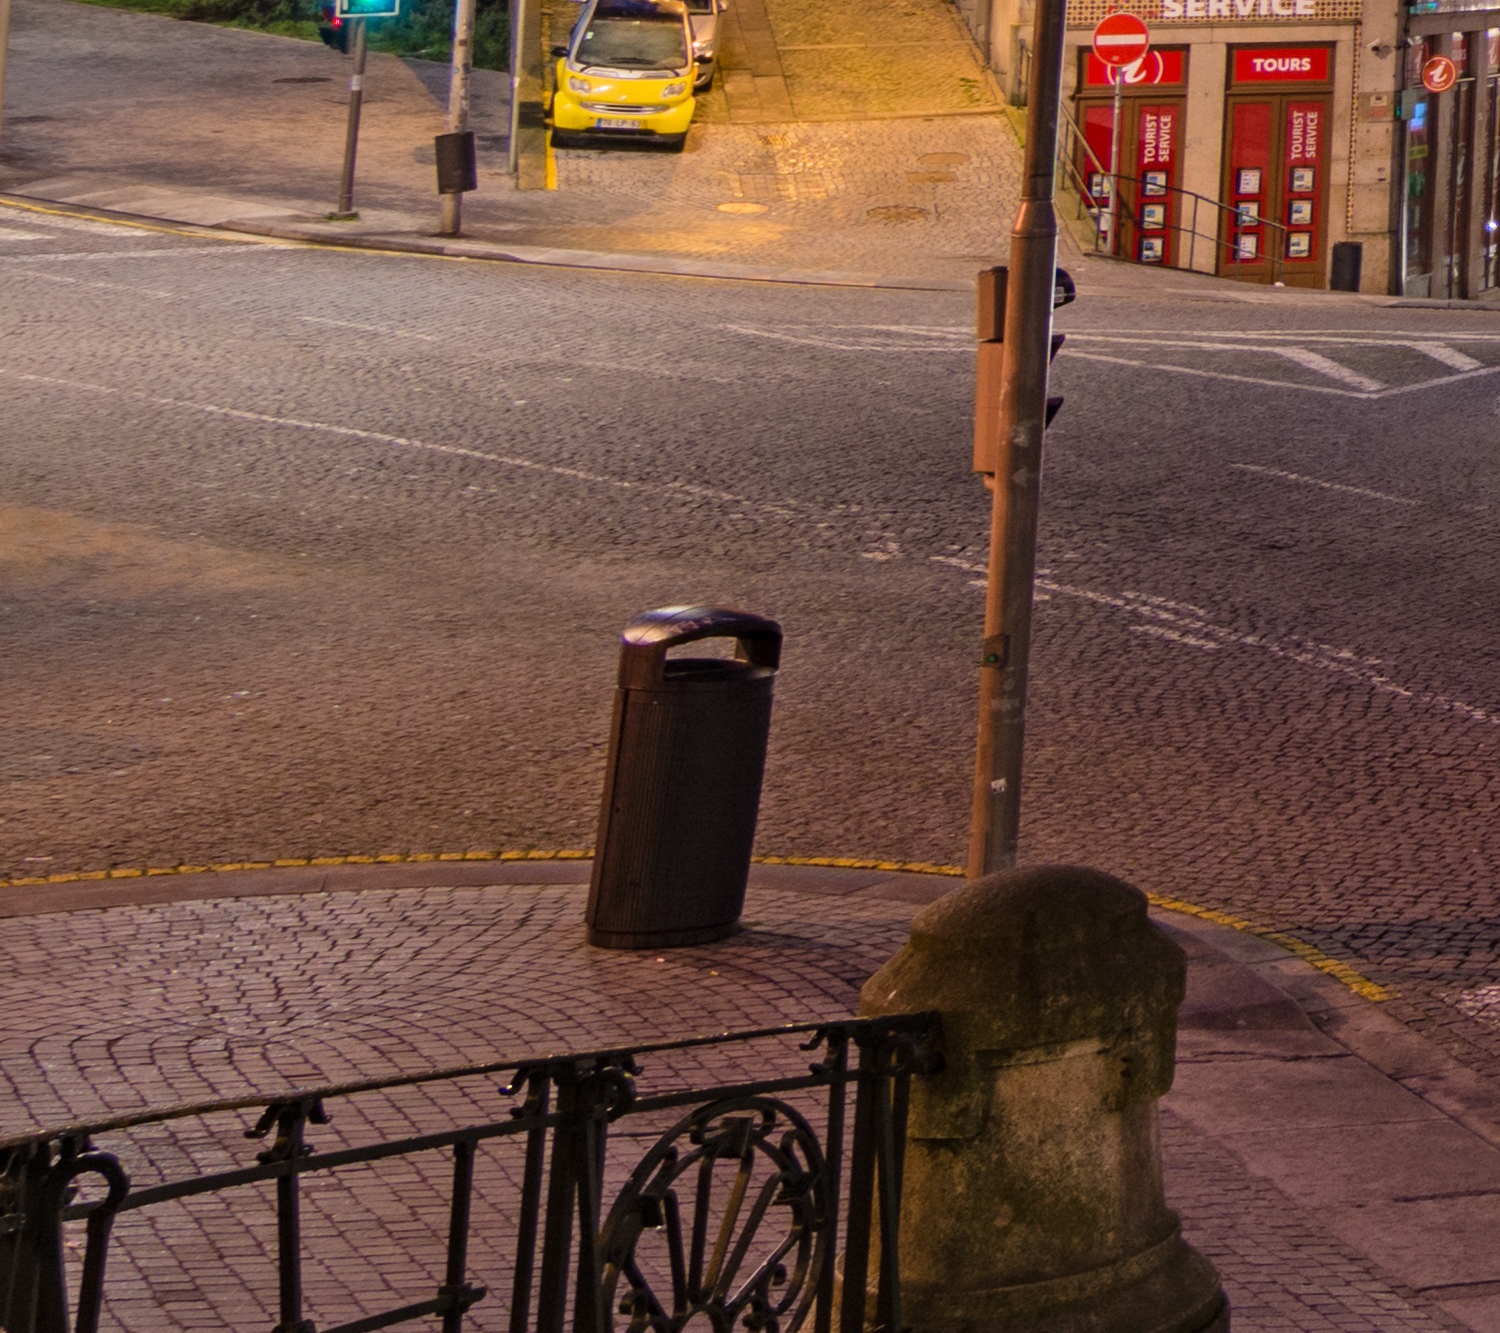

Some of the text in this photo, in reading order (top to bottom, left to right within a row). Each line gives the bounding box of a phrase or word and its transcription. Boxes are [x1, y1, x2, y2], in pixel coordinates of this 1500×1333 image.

[1252, 57, 1312, 72] TOURS
[1144, 114, 1157, 164] TOURIST
[1158, 114, 1172, 163] SERVICE
[1291, 110, 1304, 160] TOURIST
[1305, 111, 1318, 159] SERVICE
